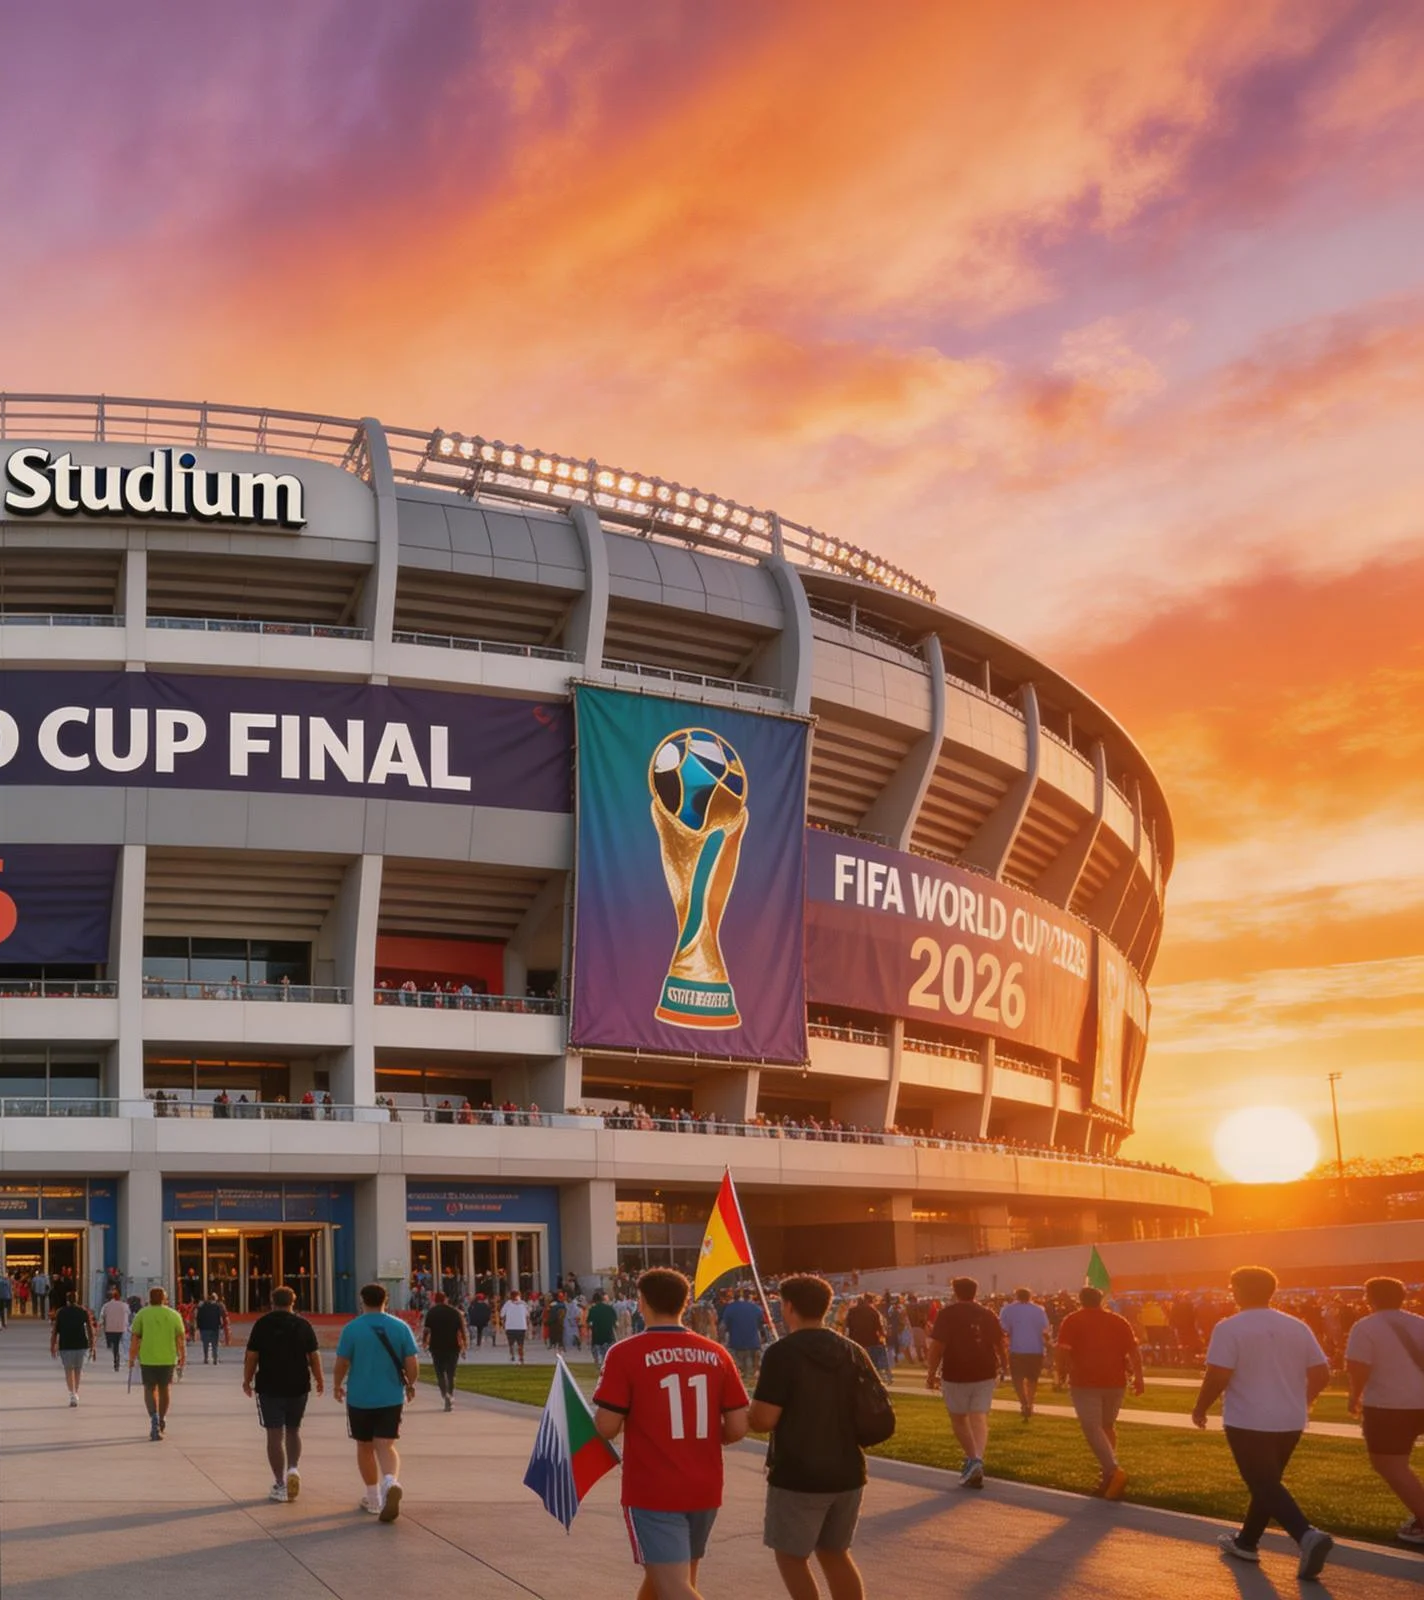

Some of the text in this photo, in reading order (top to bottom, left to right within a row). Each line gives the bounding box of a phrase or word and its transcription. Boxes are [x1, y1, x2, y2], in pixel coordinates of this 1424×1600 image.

[37, 705, 208, 773] CUP
[229, 711, 472, 792] FINAL
[833, 853, 906, 916] FIFA
[910, 871, 1007, 942] WORLD
[907, 936, 1027, 1030] 2026
[660, 1373, 709, 1440] 11
